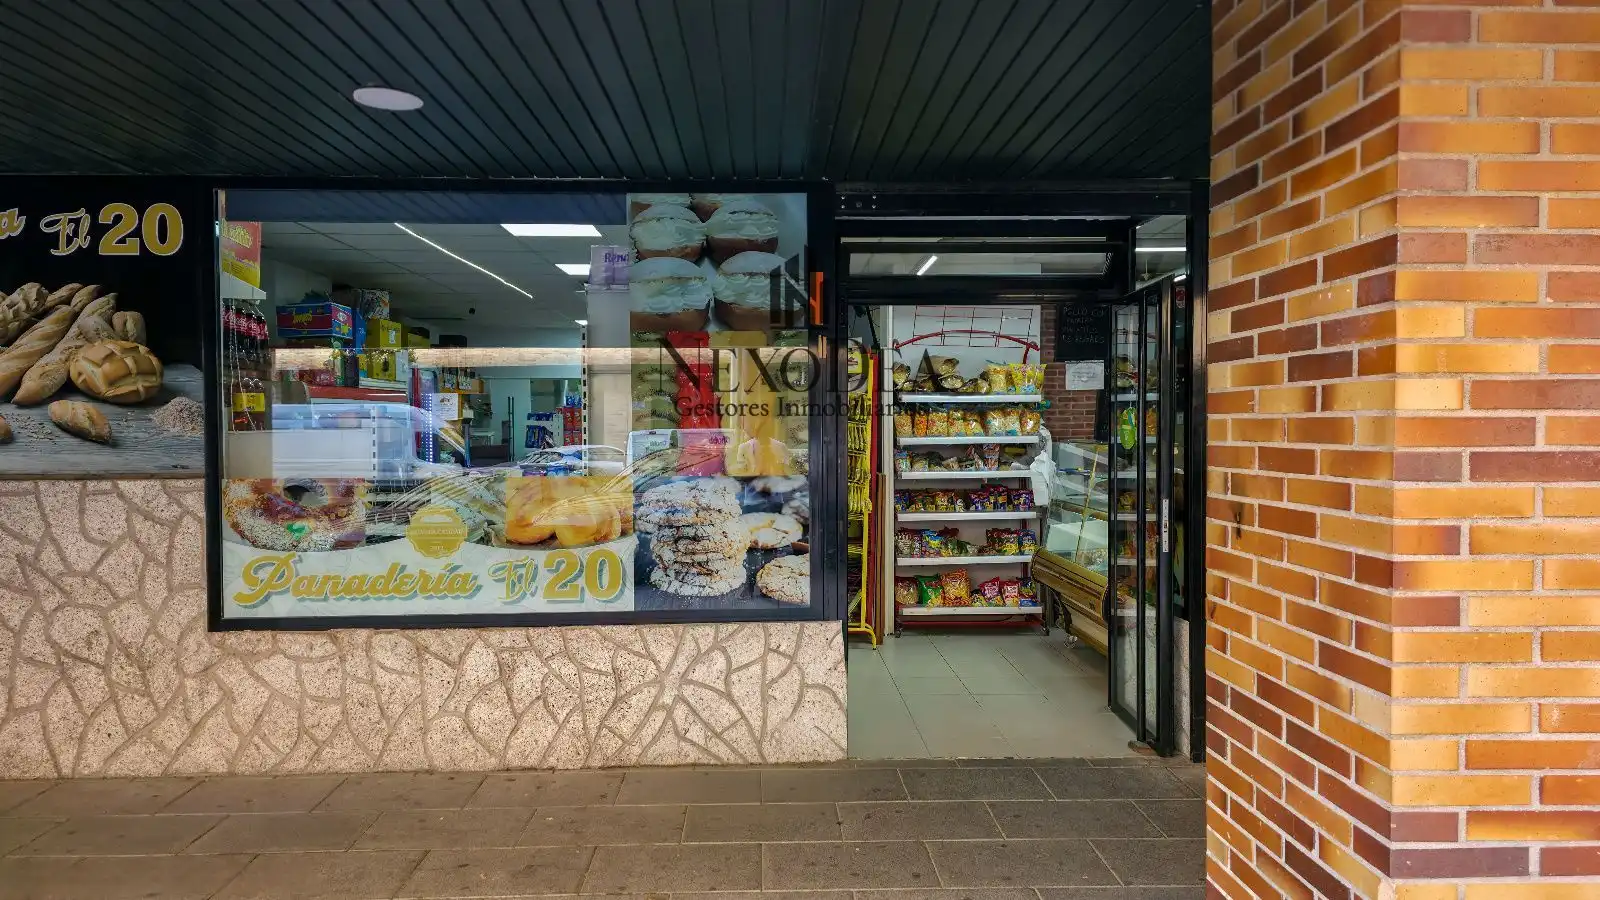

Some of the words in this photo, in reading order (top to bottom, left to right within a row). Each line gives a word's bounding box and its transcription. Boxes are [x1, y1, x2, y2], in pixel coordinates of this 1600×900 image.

[39, 207, 91, 256] El
[98, 202, 184, 256] 20
[232, 552, 481, 607] Panadería
[488, 556, 538, 602] El
[543, 548, 624, 602] 20
